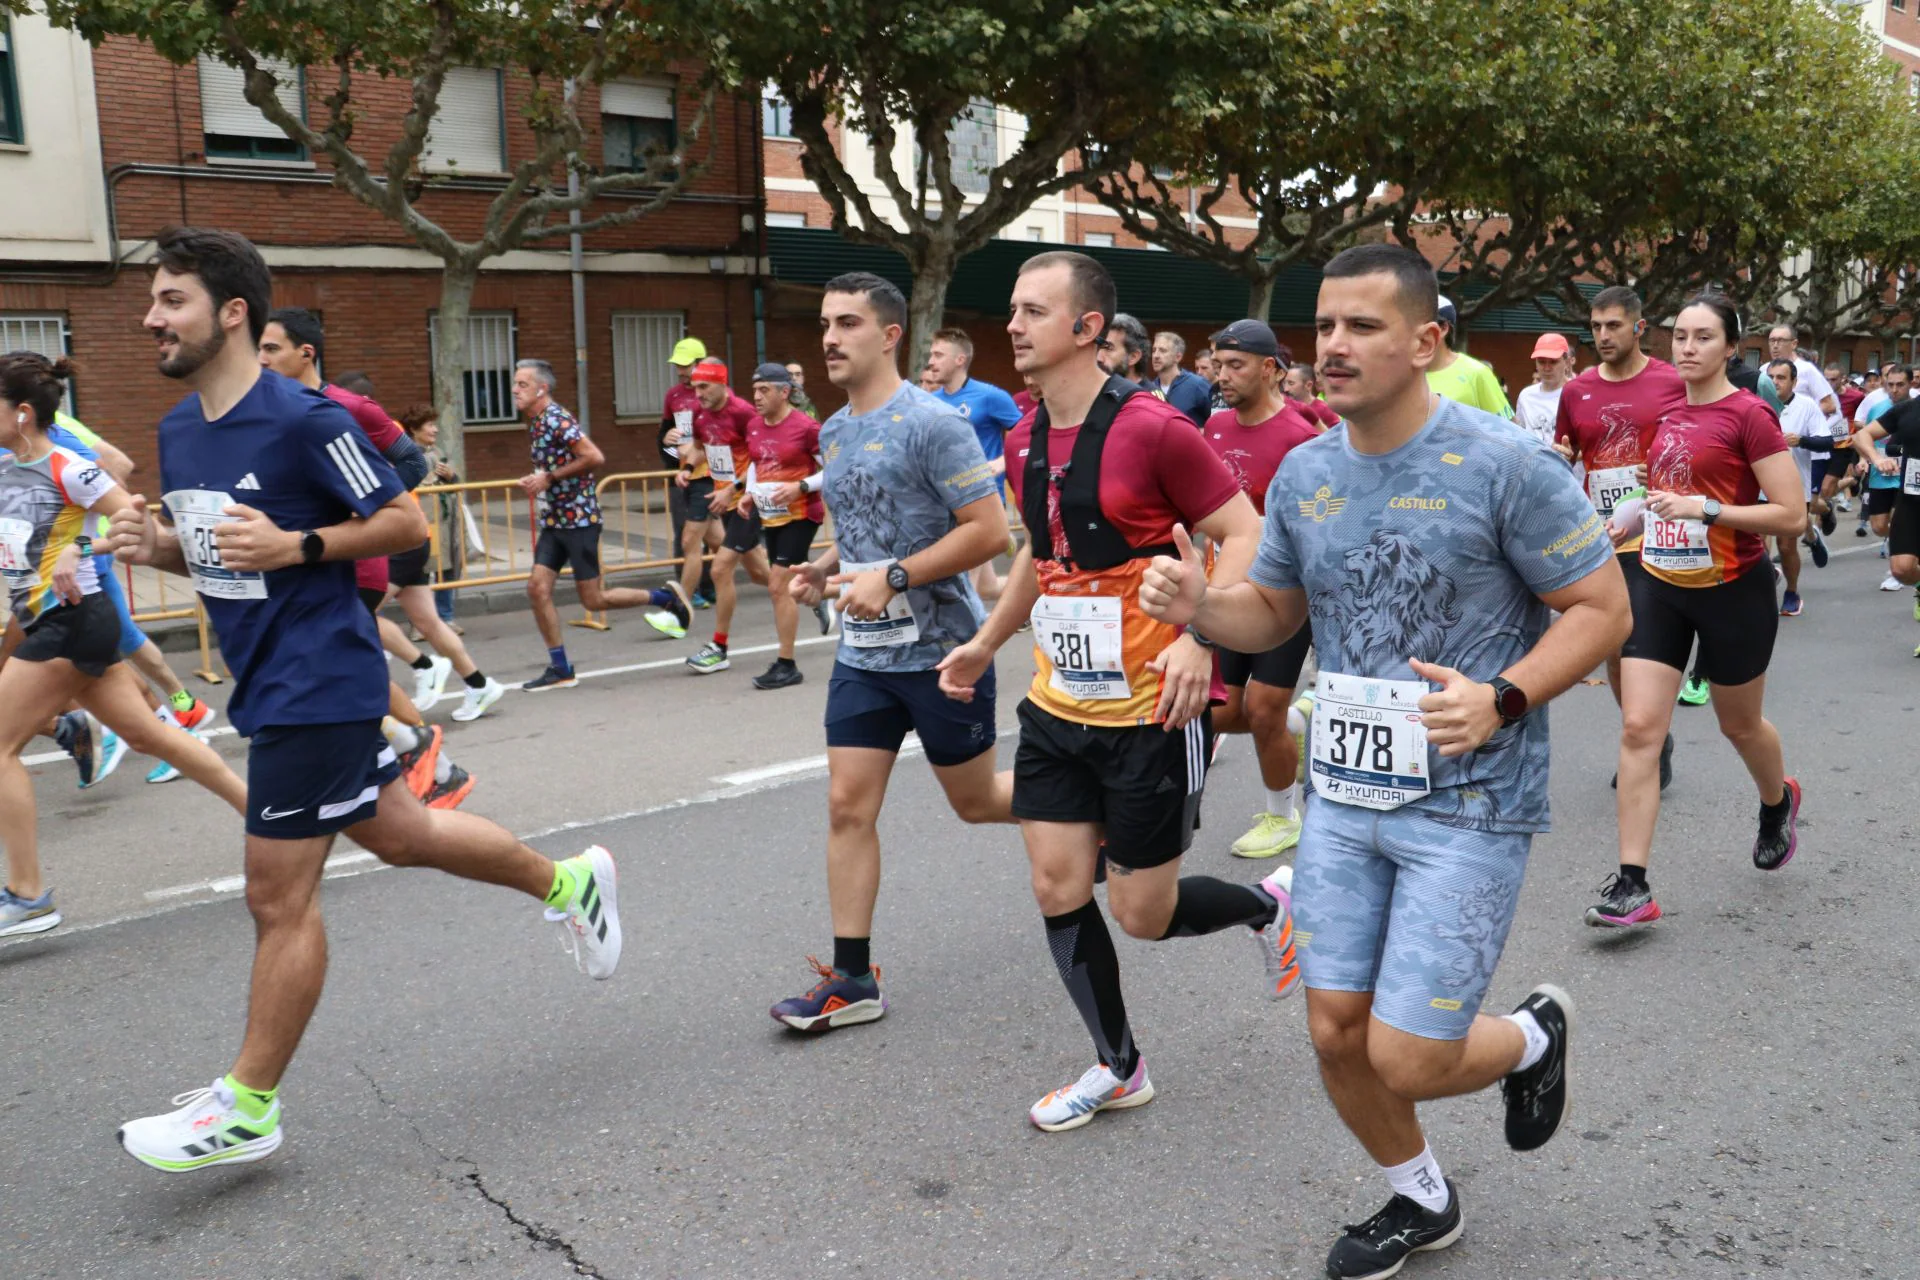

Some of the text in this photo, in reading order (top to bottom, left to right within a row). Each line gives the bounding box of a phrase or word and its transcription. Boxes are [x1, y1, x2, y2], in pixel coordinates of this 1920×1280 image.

[1390, 497, 1447, 511] CASTILLO
[1655, 520, 1690, 548] 864
[195, 527, 222, 567] 36
[1664, 557, 1698, 565] HYUNDAI
[1052, 632, 1093, 670] 381
[1391, 687, 1398, 700] k
[1337, 706, 1383, 722] CASTILLO
[1329, 718, 1393, 773] 378
[1344, 784, 1405, 803] HYUNDAI
